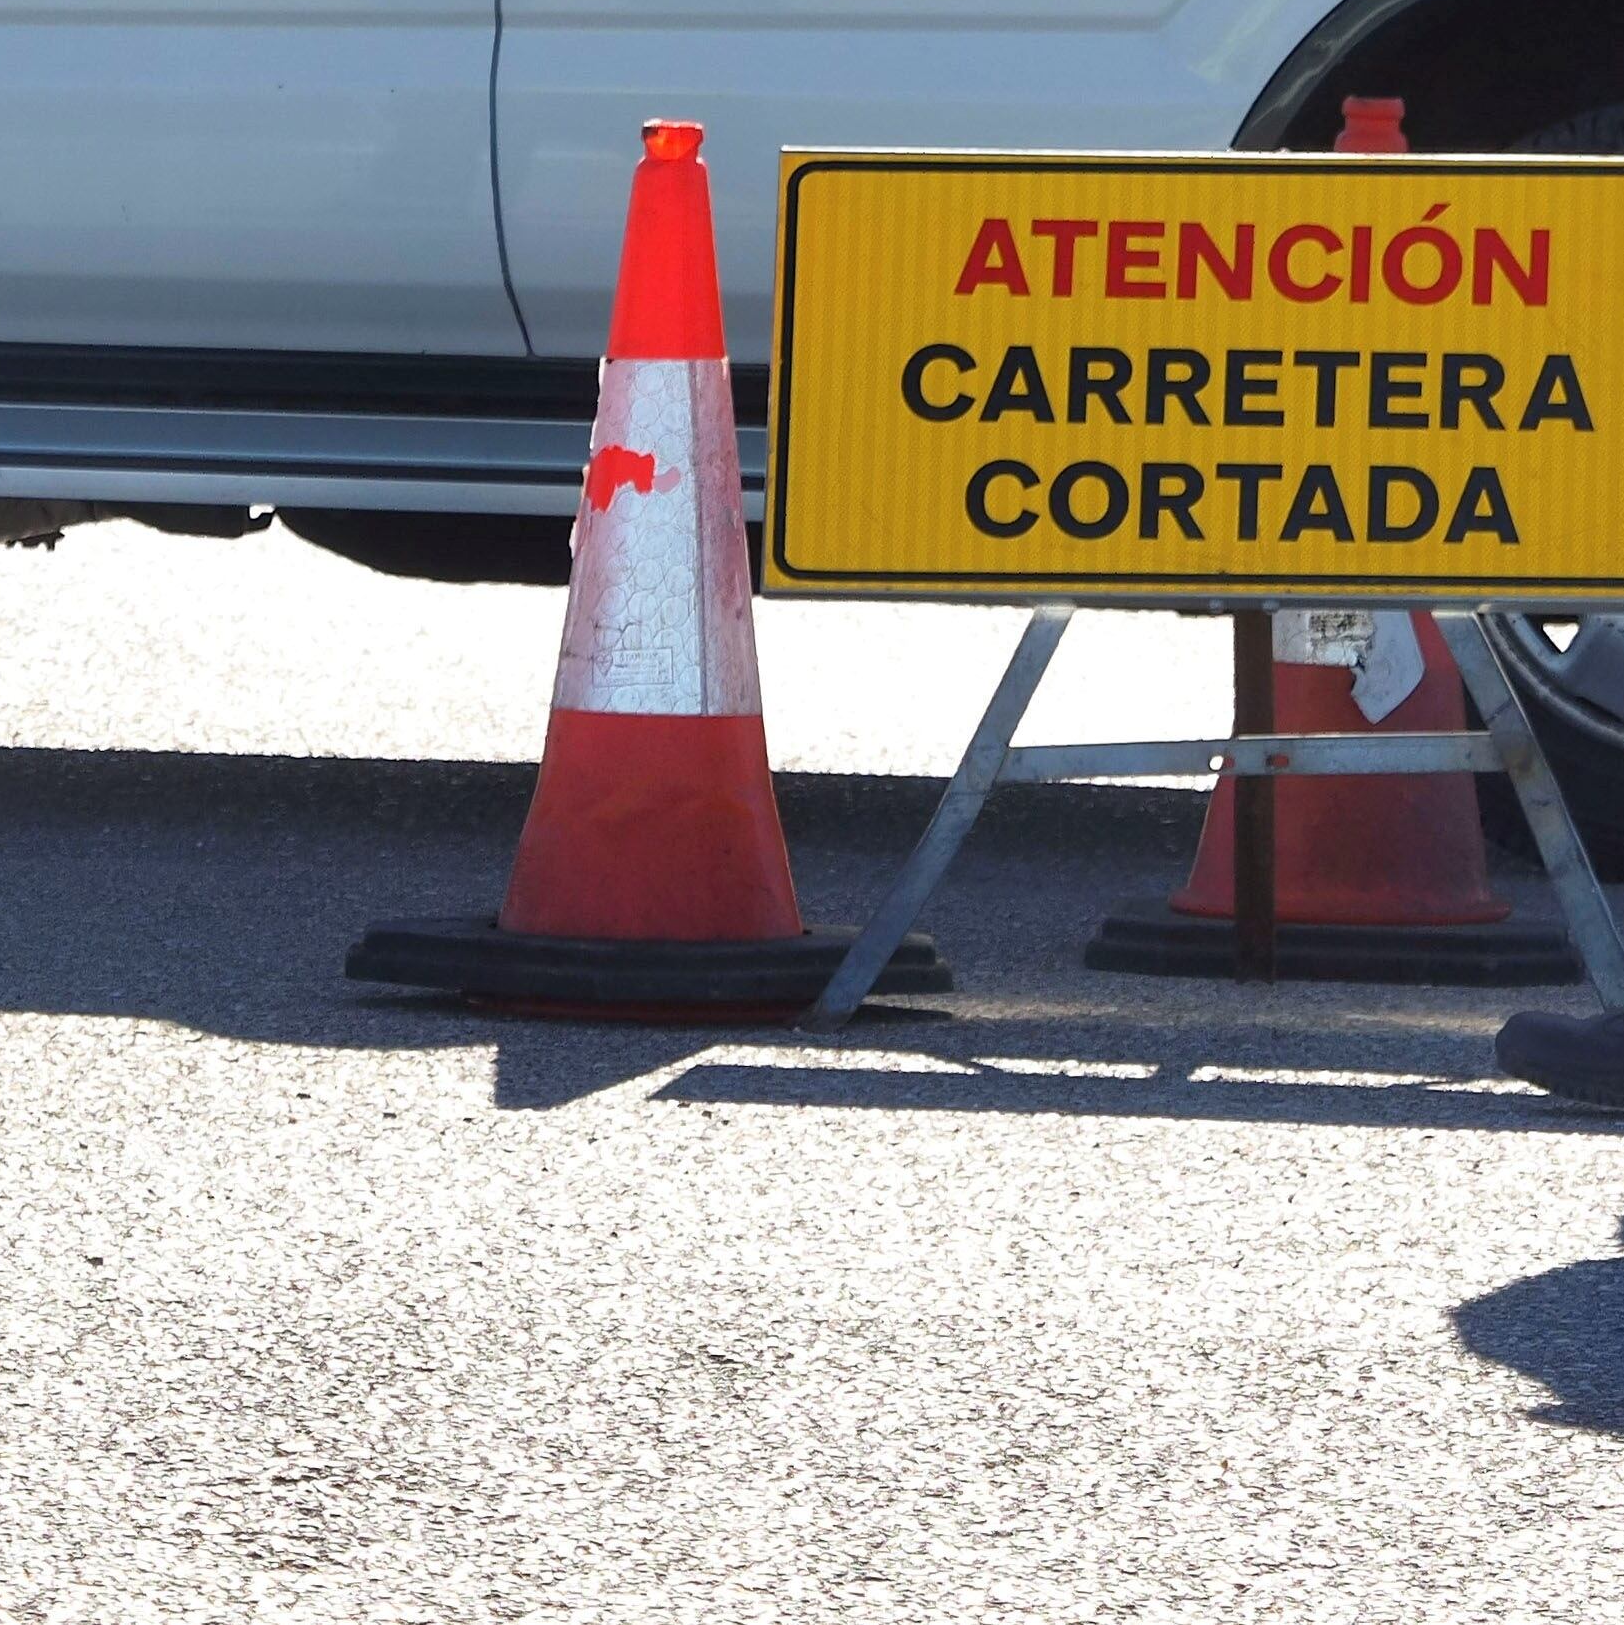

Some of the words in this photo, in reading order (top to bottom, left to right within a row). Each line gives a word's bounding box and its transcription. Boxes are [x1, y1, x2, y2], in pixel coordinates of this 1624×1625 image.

[953, 203, 1551, 307] ATENCIÓN
[900, 343, 1595, 432] CARRETERA
[964, 458, 1521, 544] CORTADA
